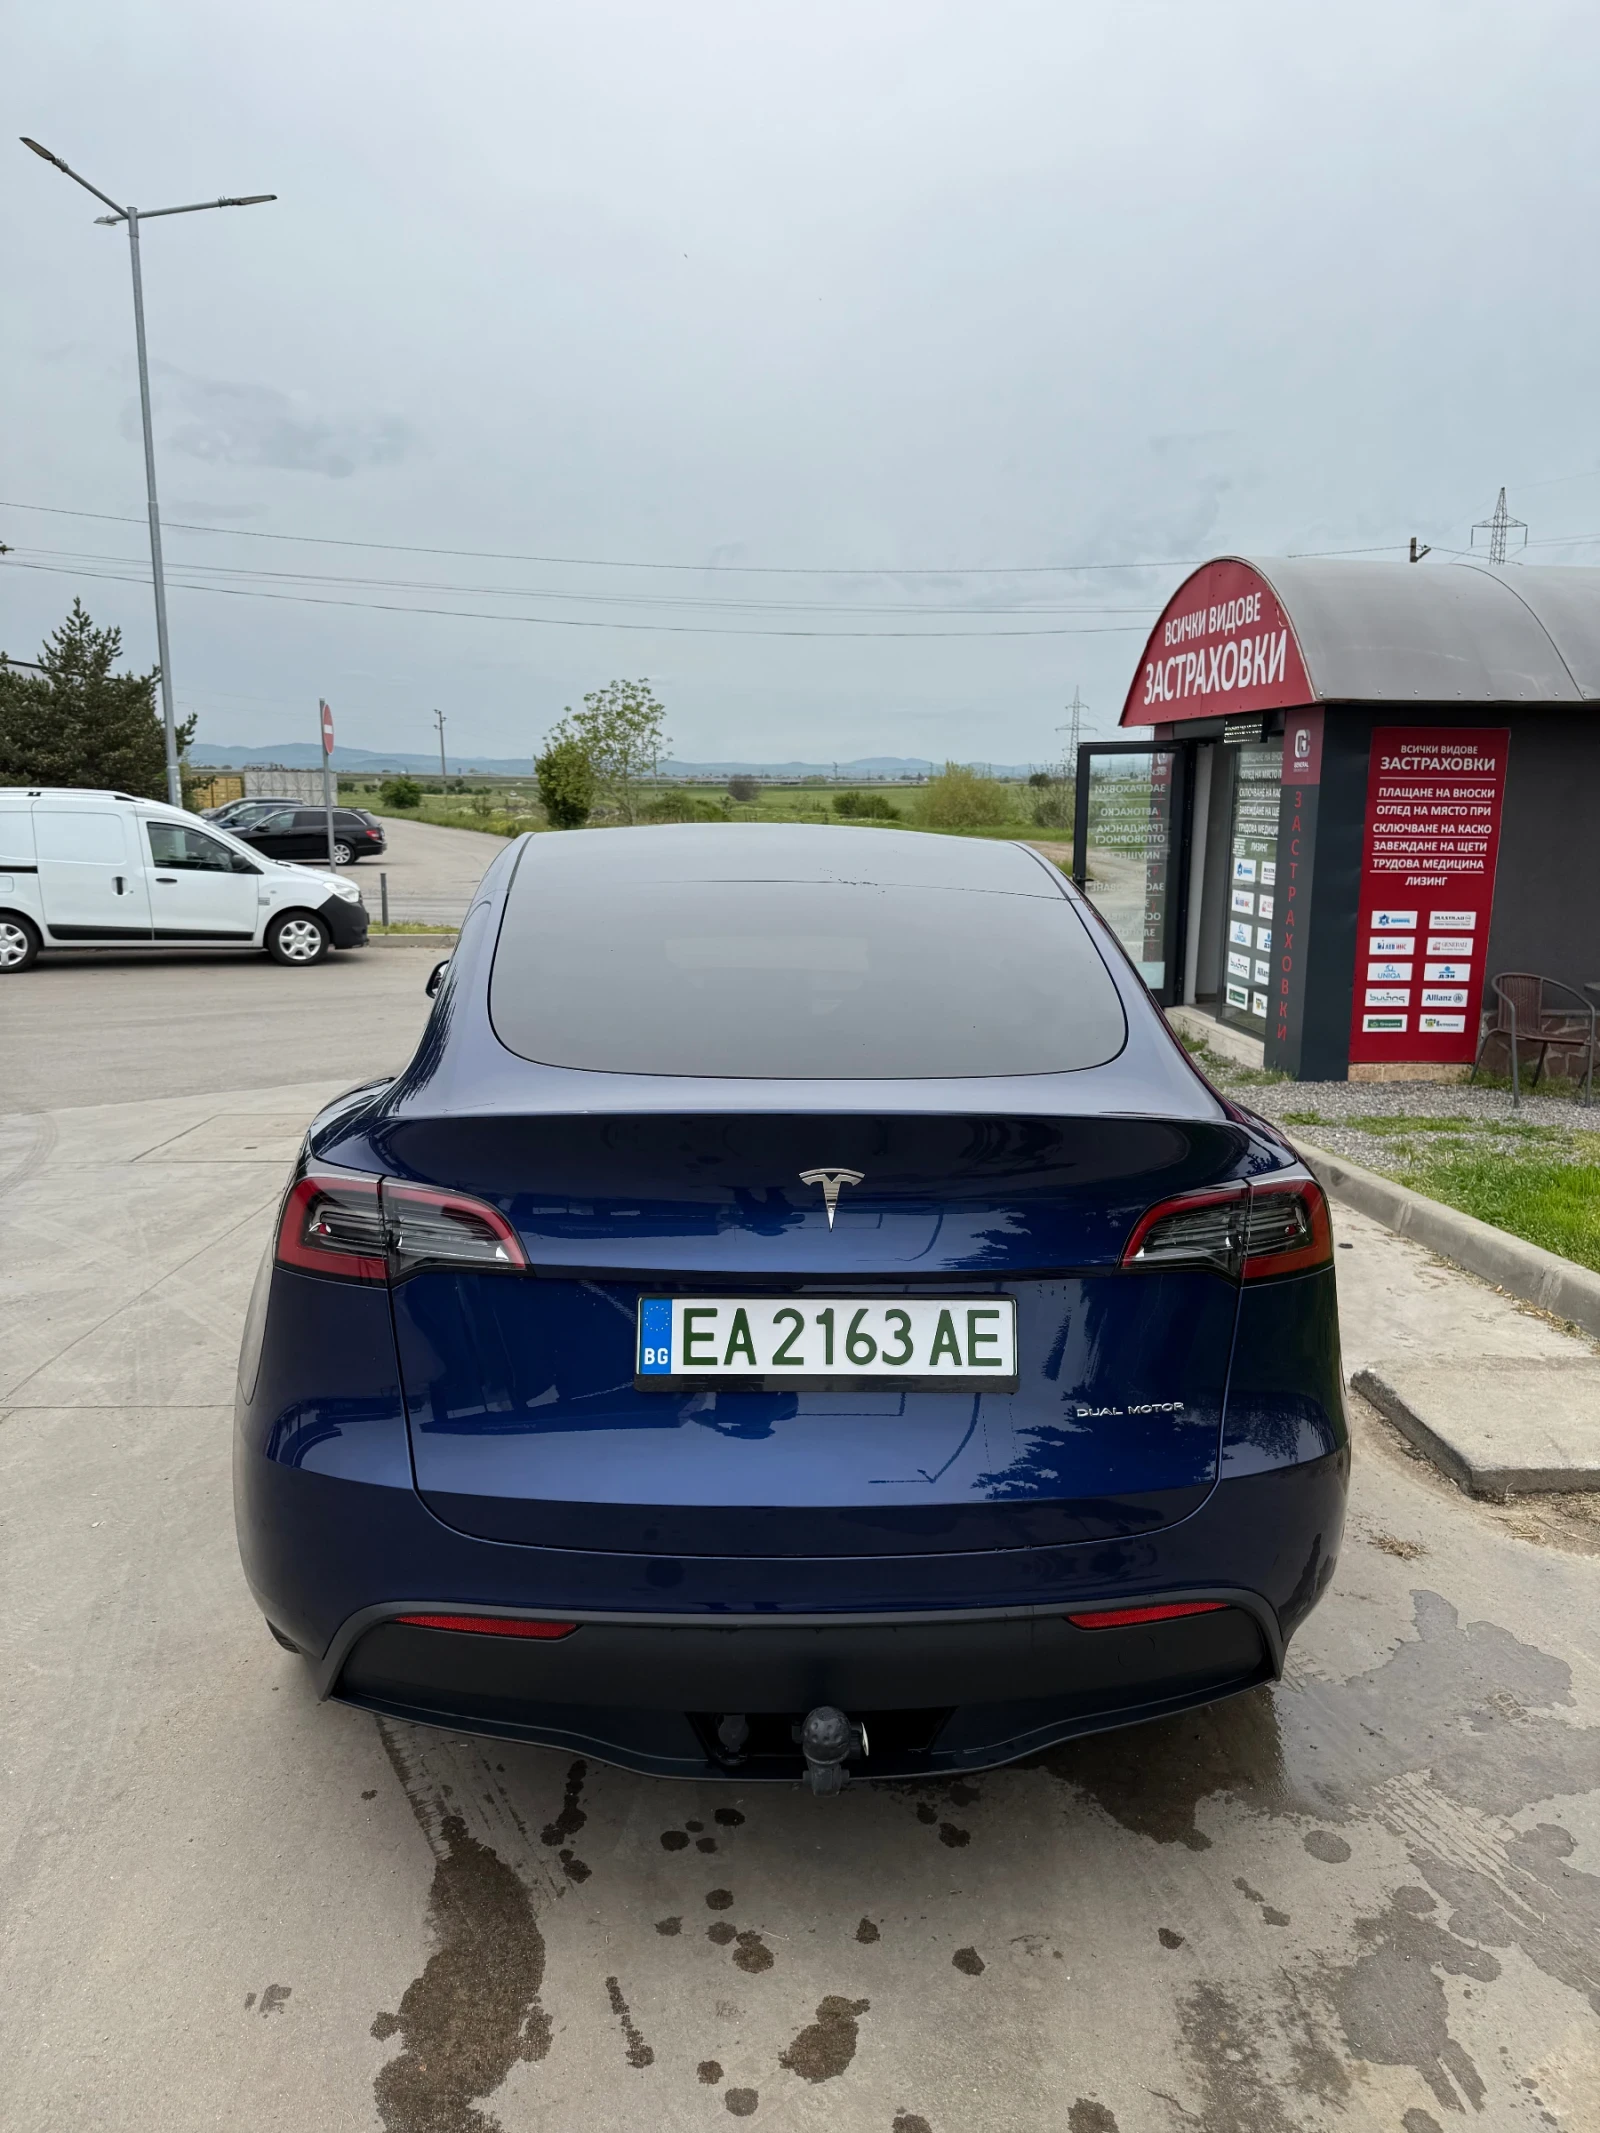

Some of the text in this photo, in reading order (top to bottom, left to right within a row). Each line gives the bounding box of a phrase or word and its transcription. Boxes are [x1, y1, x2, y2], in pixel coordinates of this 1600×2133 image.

[1165, 592, 1261, 646] ВСИЧКИ ВИДОВЕ
[1144, 629, 1287, 705] ЗАСТРАХОВКИ
[1400, 745, 1478, 755] ВСИЧКИ ВИДОВЕ
[1380, 757, 1496, 771] ЗАСТРАХОВКИ
[1379, 787, 1495, 799] ПЛАЩАНЕ НА ВНОСКИ
[1376, 806, 1491, 817] ОГЛЕД НА МЯСТО ПРИ
[1373, 823, 1492, 834] СКЛЮЧВАНЕ НА КАСКО
[1373, 841, 1487, 853] ЗАВЕЖДАНЕ НА ЩЕТИ
[1373, 859, 1484, 870] ТРУДОВА МЕДИЦИНА
[1405, 876, 1448, 886] ЛИЗИНГ
[1277, 791, 1302, 1041] ЗАСТРАХОВКИ
[683, 1307, 1002, 1366] EA 2163 AE
[644, 1348, 668, 1365] BG
[1077, 1402, 1184, 1417] DUAL MOTOR
